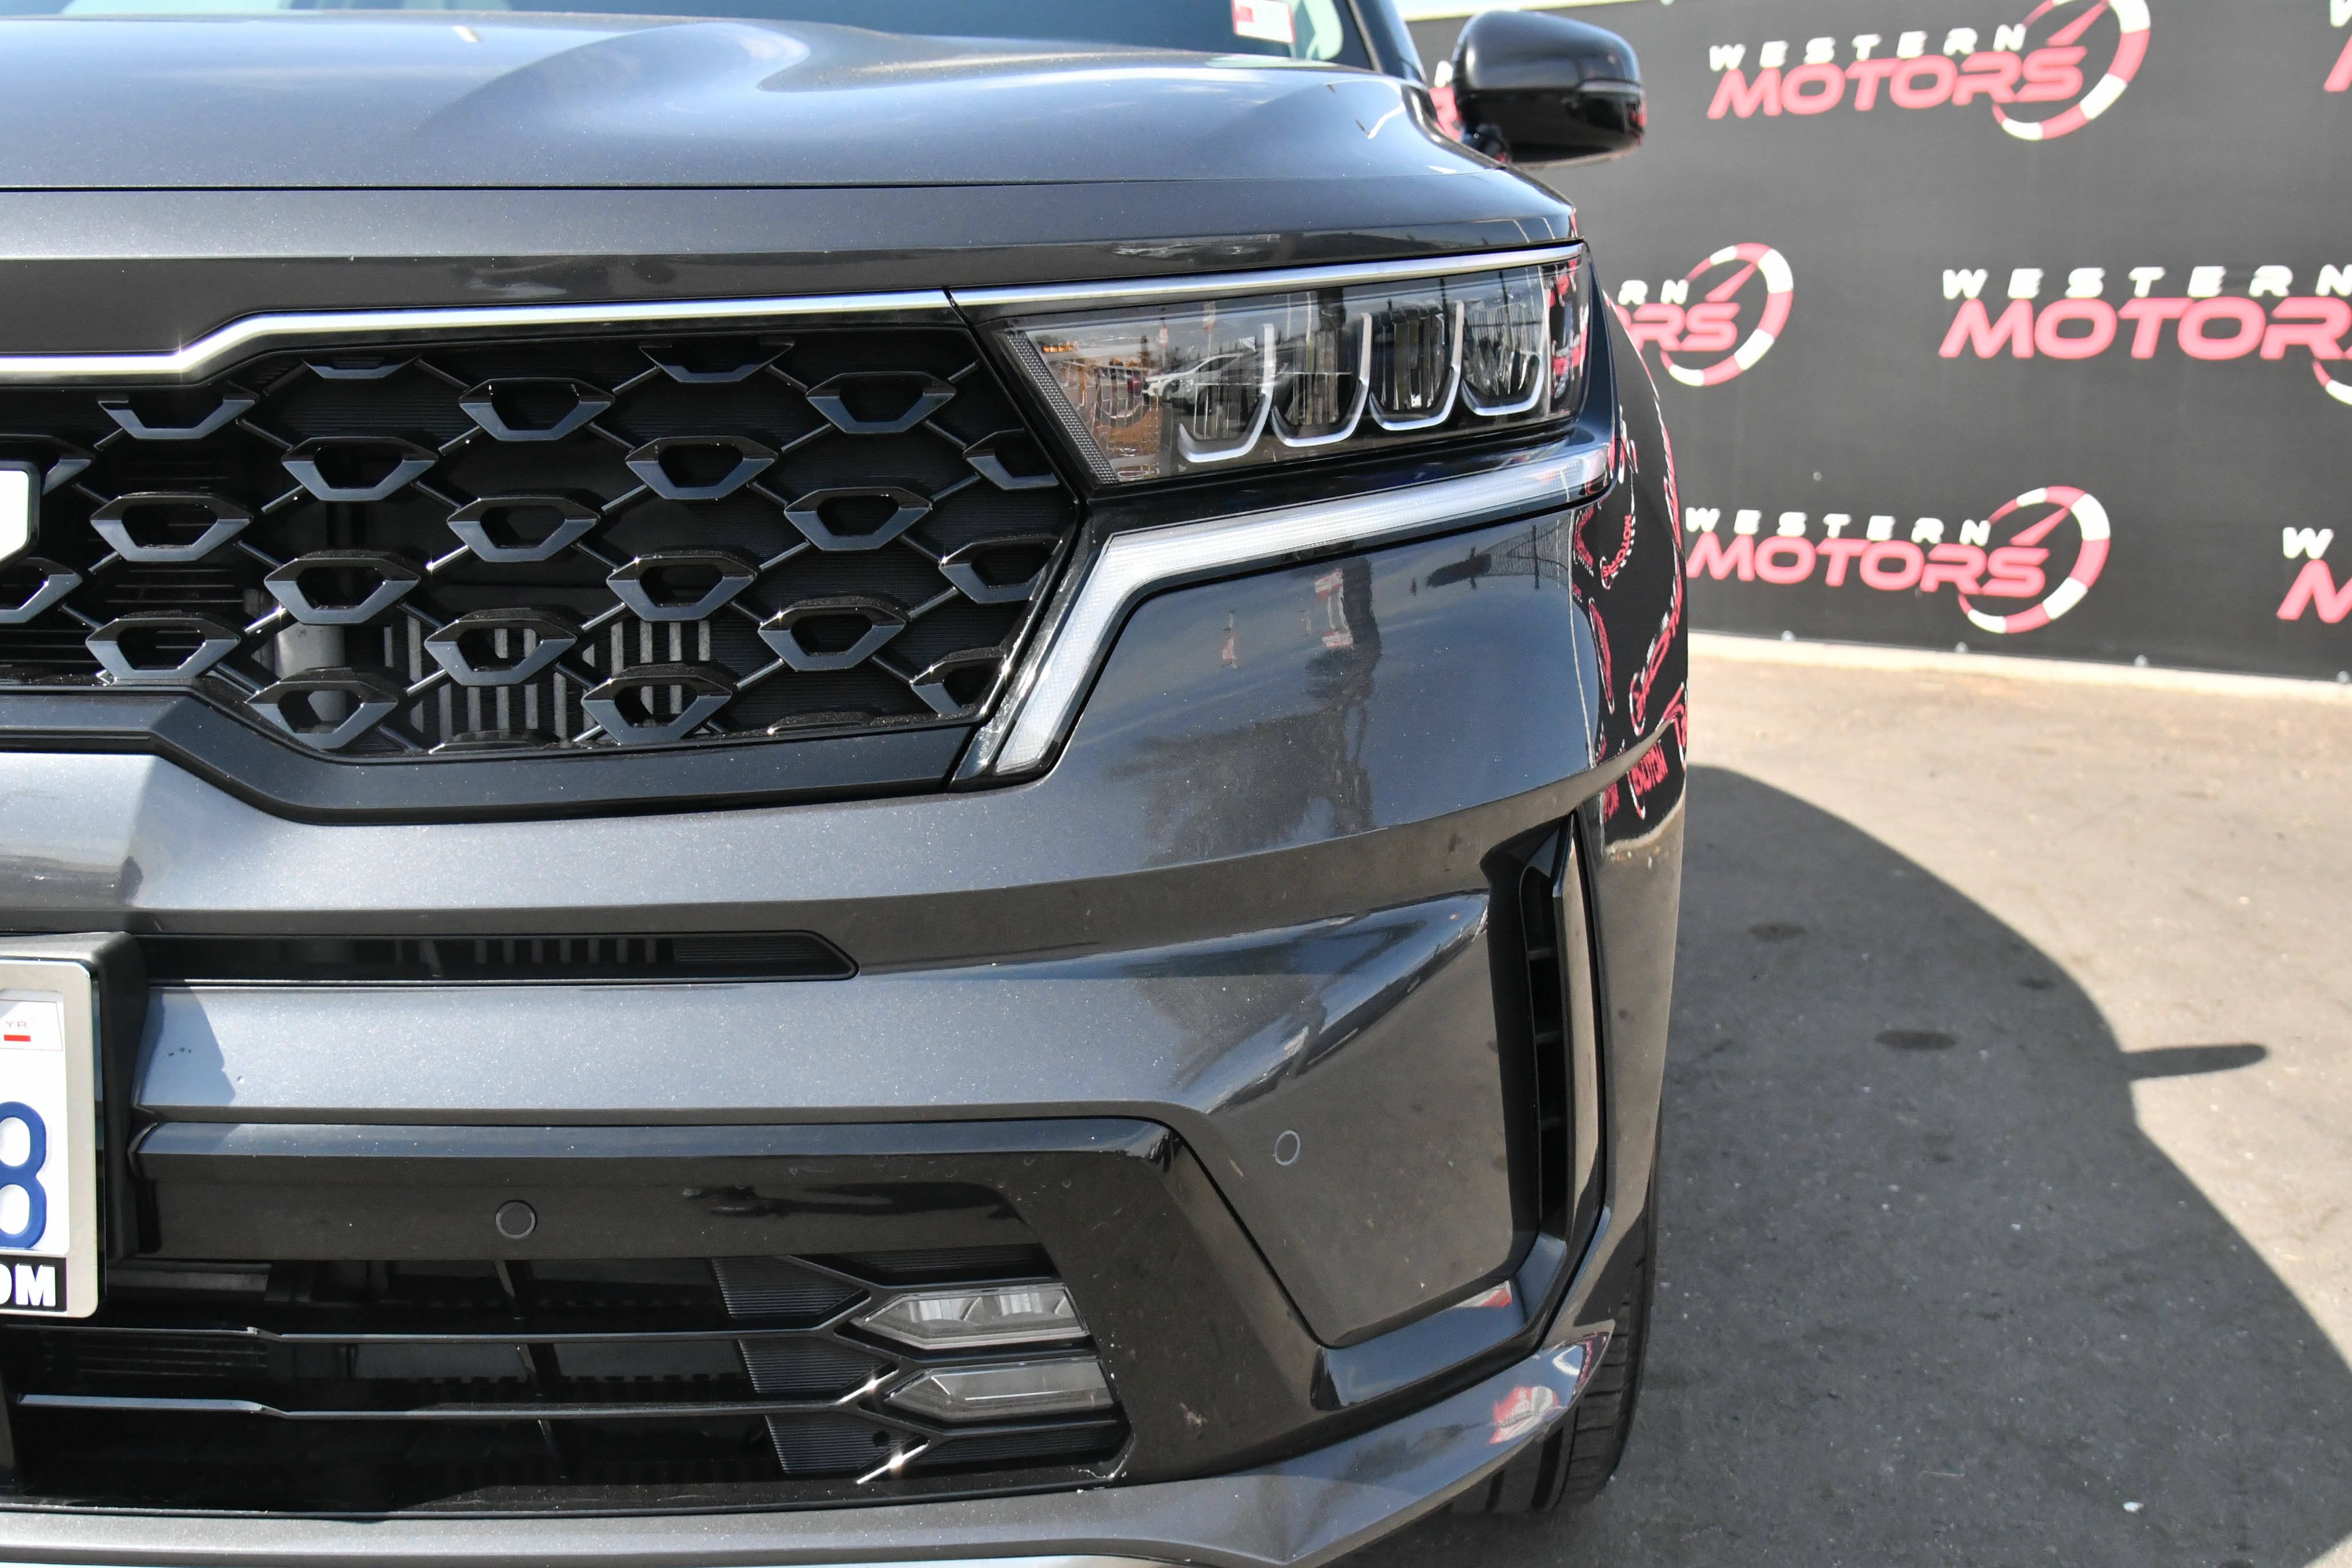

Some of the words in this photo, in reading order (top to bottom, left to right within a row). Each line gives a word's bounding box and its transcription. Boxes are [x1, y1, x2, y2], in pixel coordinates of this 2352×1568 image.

[1710, 24, 2027, 71] WESTERN
[1707, 46, 2086, 119] MOTORS
[1942, 264, 2352, 299] WESTERN
[1611, 302, 1741, 351] RS
[1938, 296, 2352, 360] MOTOR
[1686, 507, 1990, 547] WESTERN
[1686, 532, 2050, 597] MOTORS
